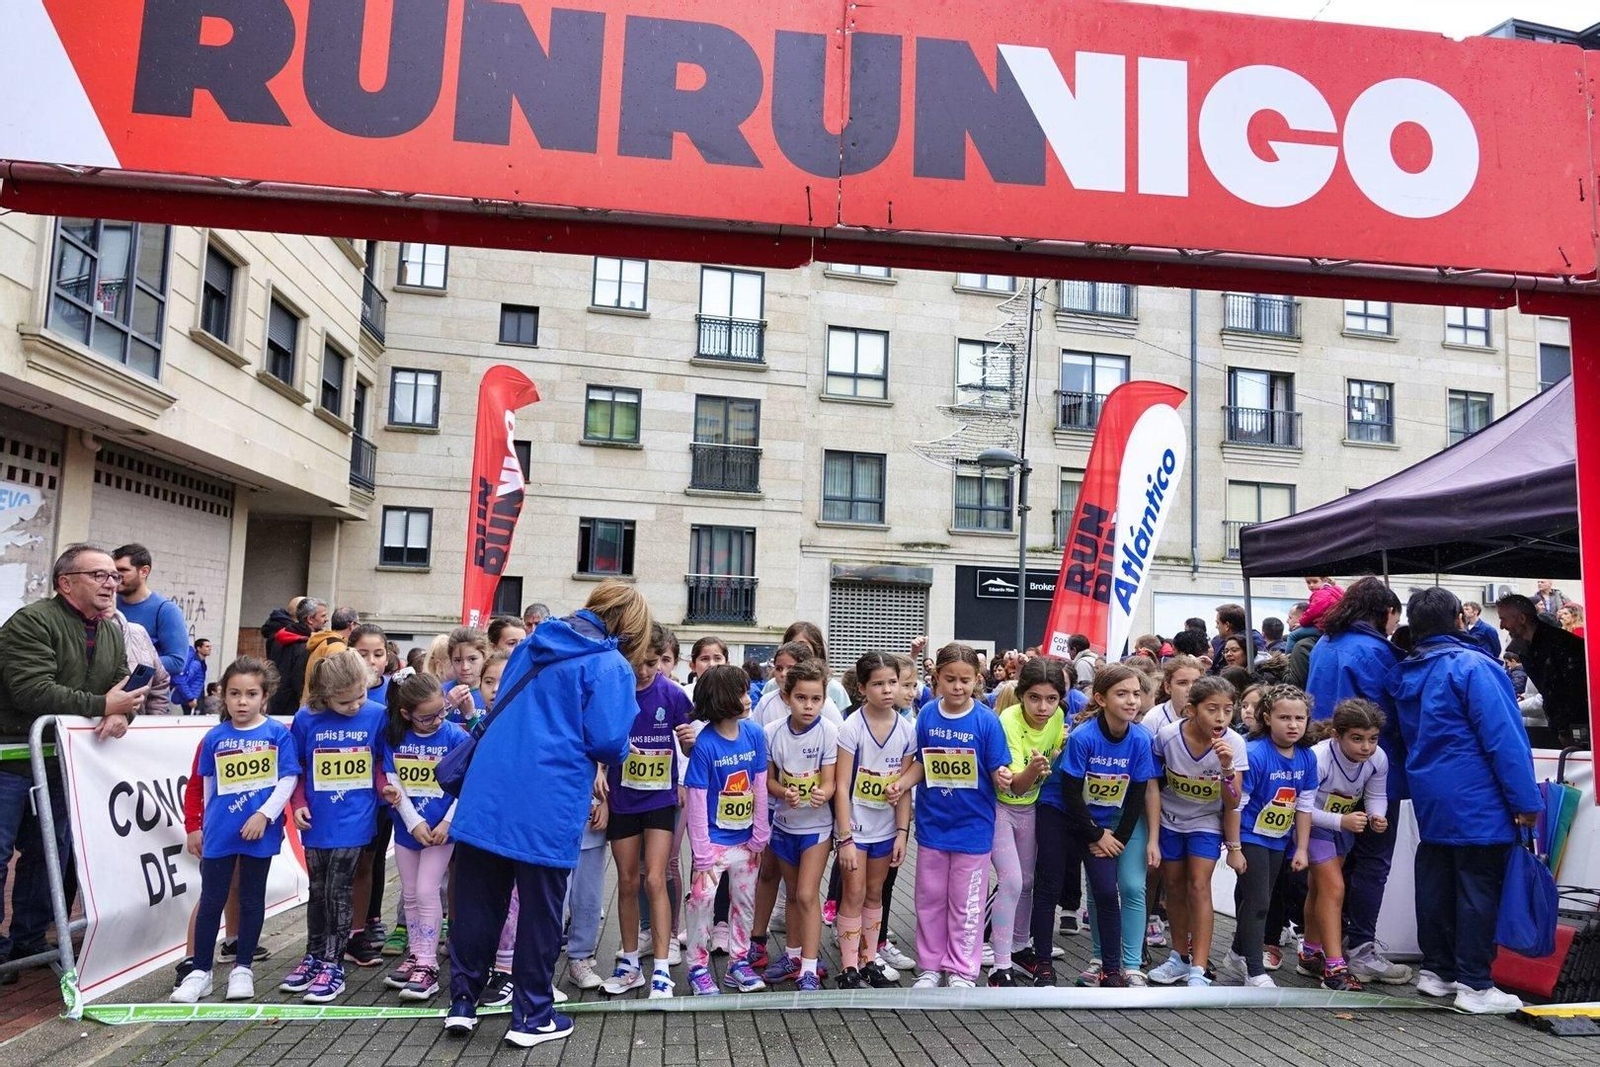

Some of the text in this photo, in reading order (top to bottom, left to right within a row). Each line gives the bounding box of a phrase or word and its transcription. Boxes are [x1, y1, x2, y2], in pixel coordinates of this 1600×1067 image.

[1114, 448, 1176, 617] Atlántico
[1064, 502, 1109, 597] RUN
[315, 729, 338, 742] máis
[345, 731, 368, 742] auga
[952, 731, 974, 743] auga
[400, 744, 420, 754] máis
[426, 745, 448, 756] auga
[225, 757, 271, 778] 8098
[321, 759, 366, 776] 8108
[629, 760, 665, 777] 8015
[931, 760, 972, 776] 8068
[140, 843, 187, 907] DE
